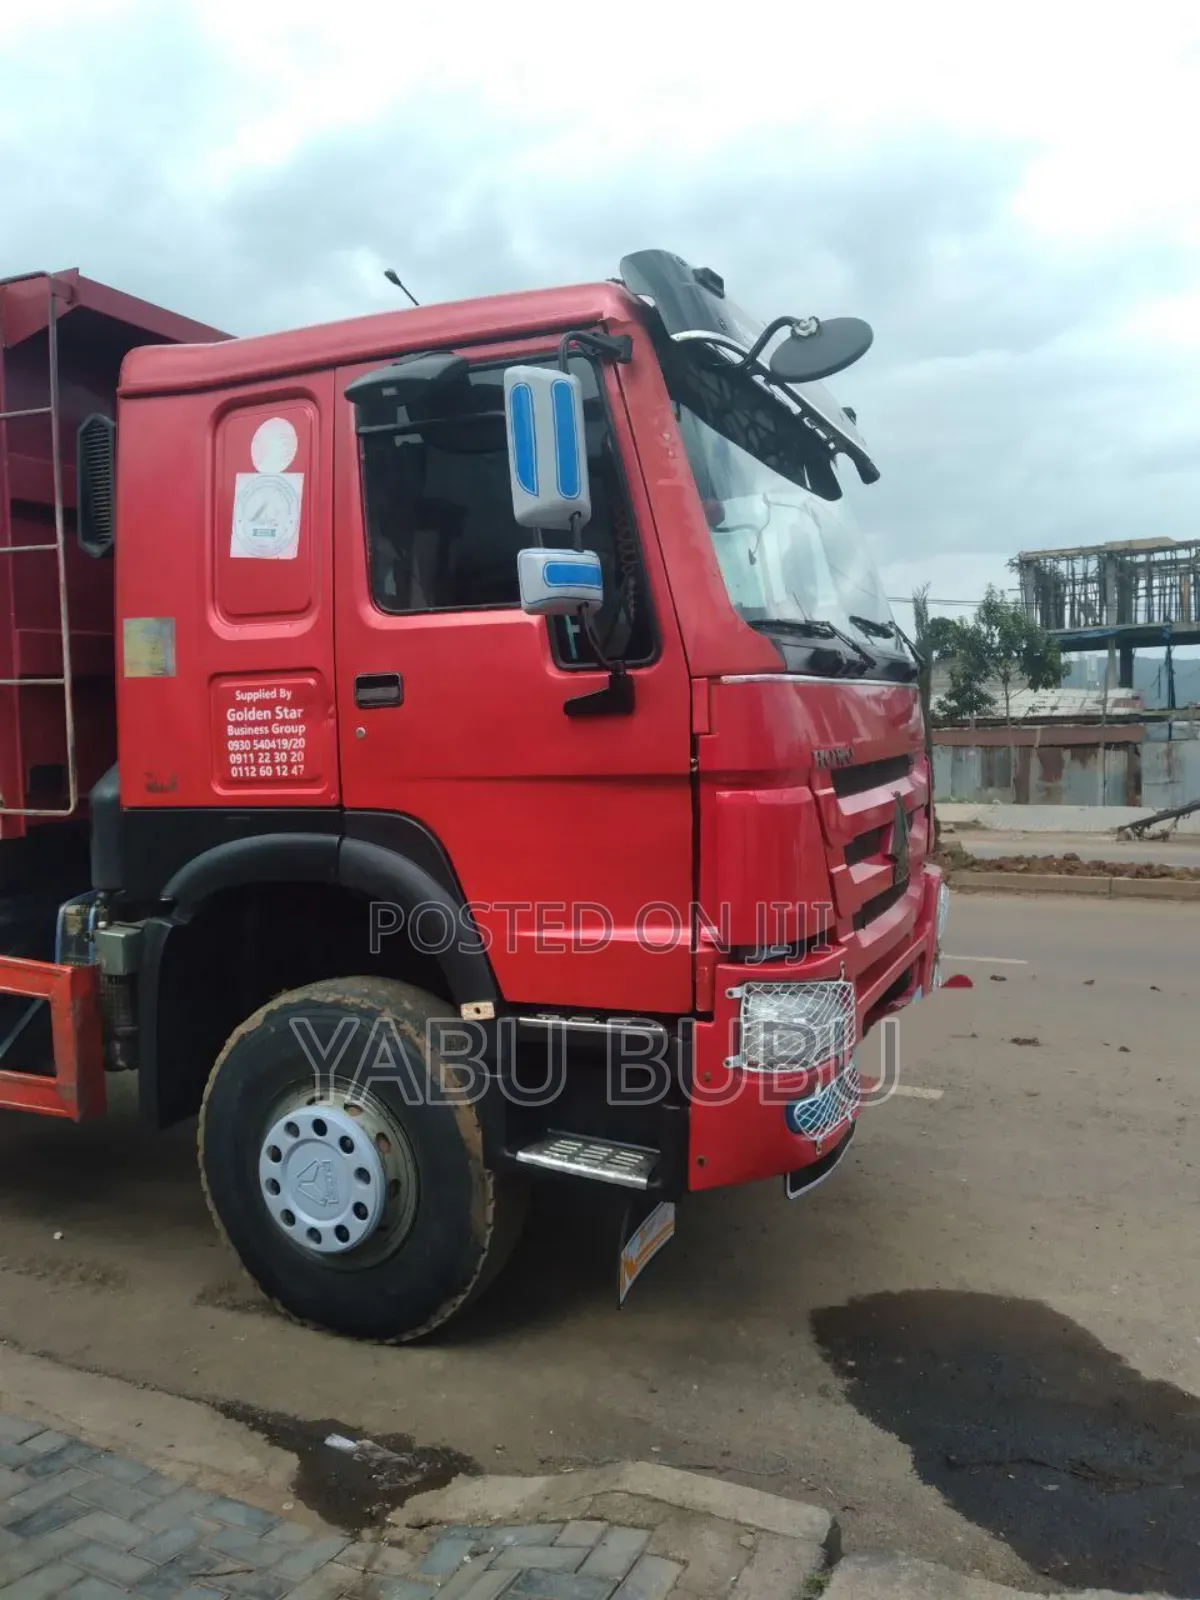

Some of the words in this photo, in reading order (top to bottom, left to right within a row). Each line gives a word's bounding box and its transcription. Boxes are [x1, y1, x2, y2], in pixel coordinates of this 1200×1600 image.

[235, 689, 277, 702] Supplied
[279, 688, 292, 700] By
[226, 707, 271, 721] Golden
[275, 706, 304, 719] Star
[227, 725, 269, 736] Business
[271, 723, 306, 736] Group
[228, 740, 251, 751] 0930
[229, 753, 254, 764] 0911
[258, 753, 271, 763] 22
[273, 752, 287, 762] 30
[290, 751, 304, 762] 20
[231, 767, 256, 777] 0112
[259, 767, 273, 776] 60
[276, 766, 288, 776] 12
